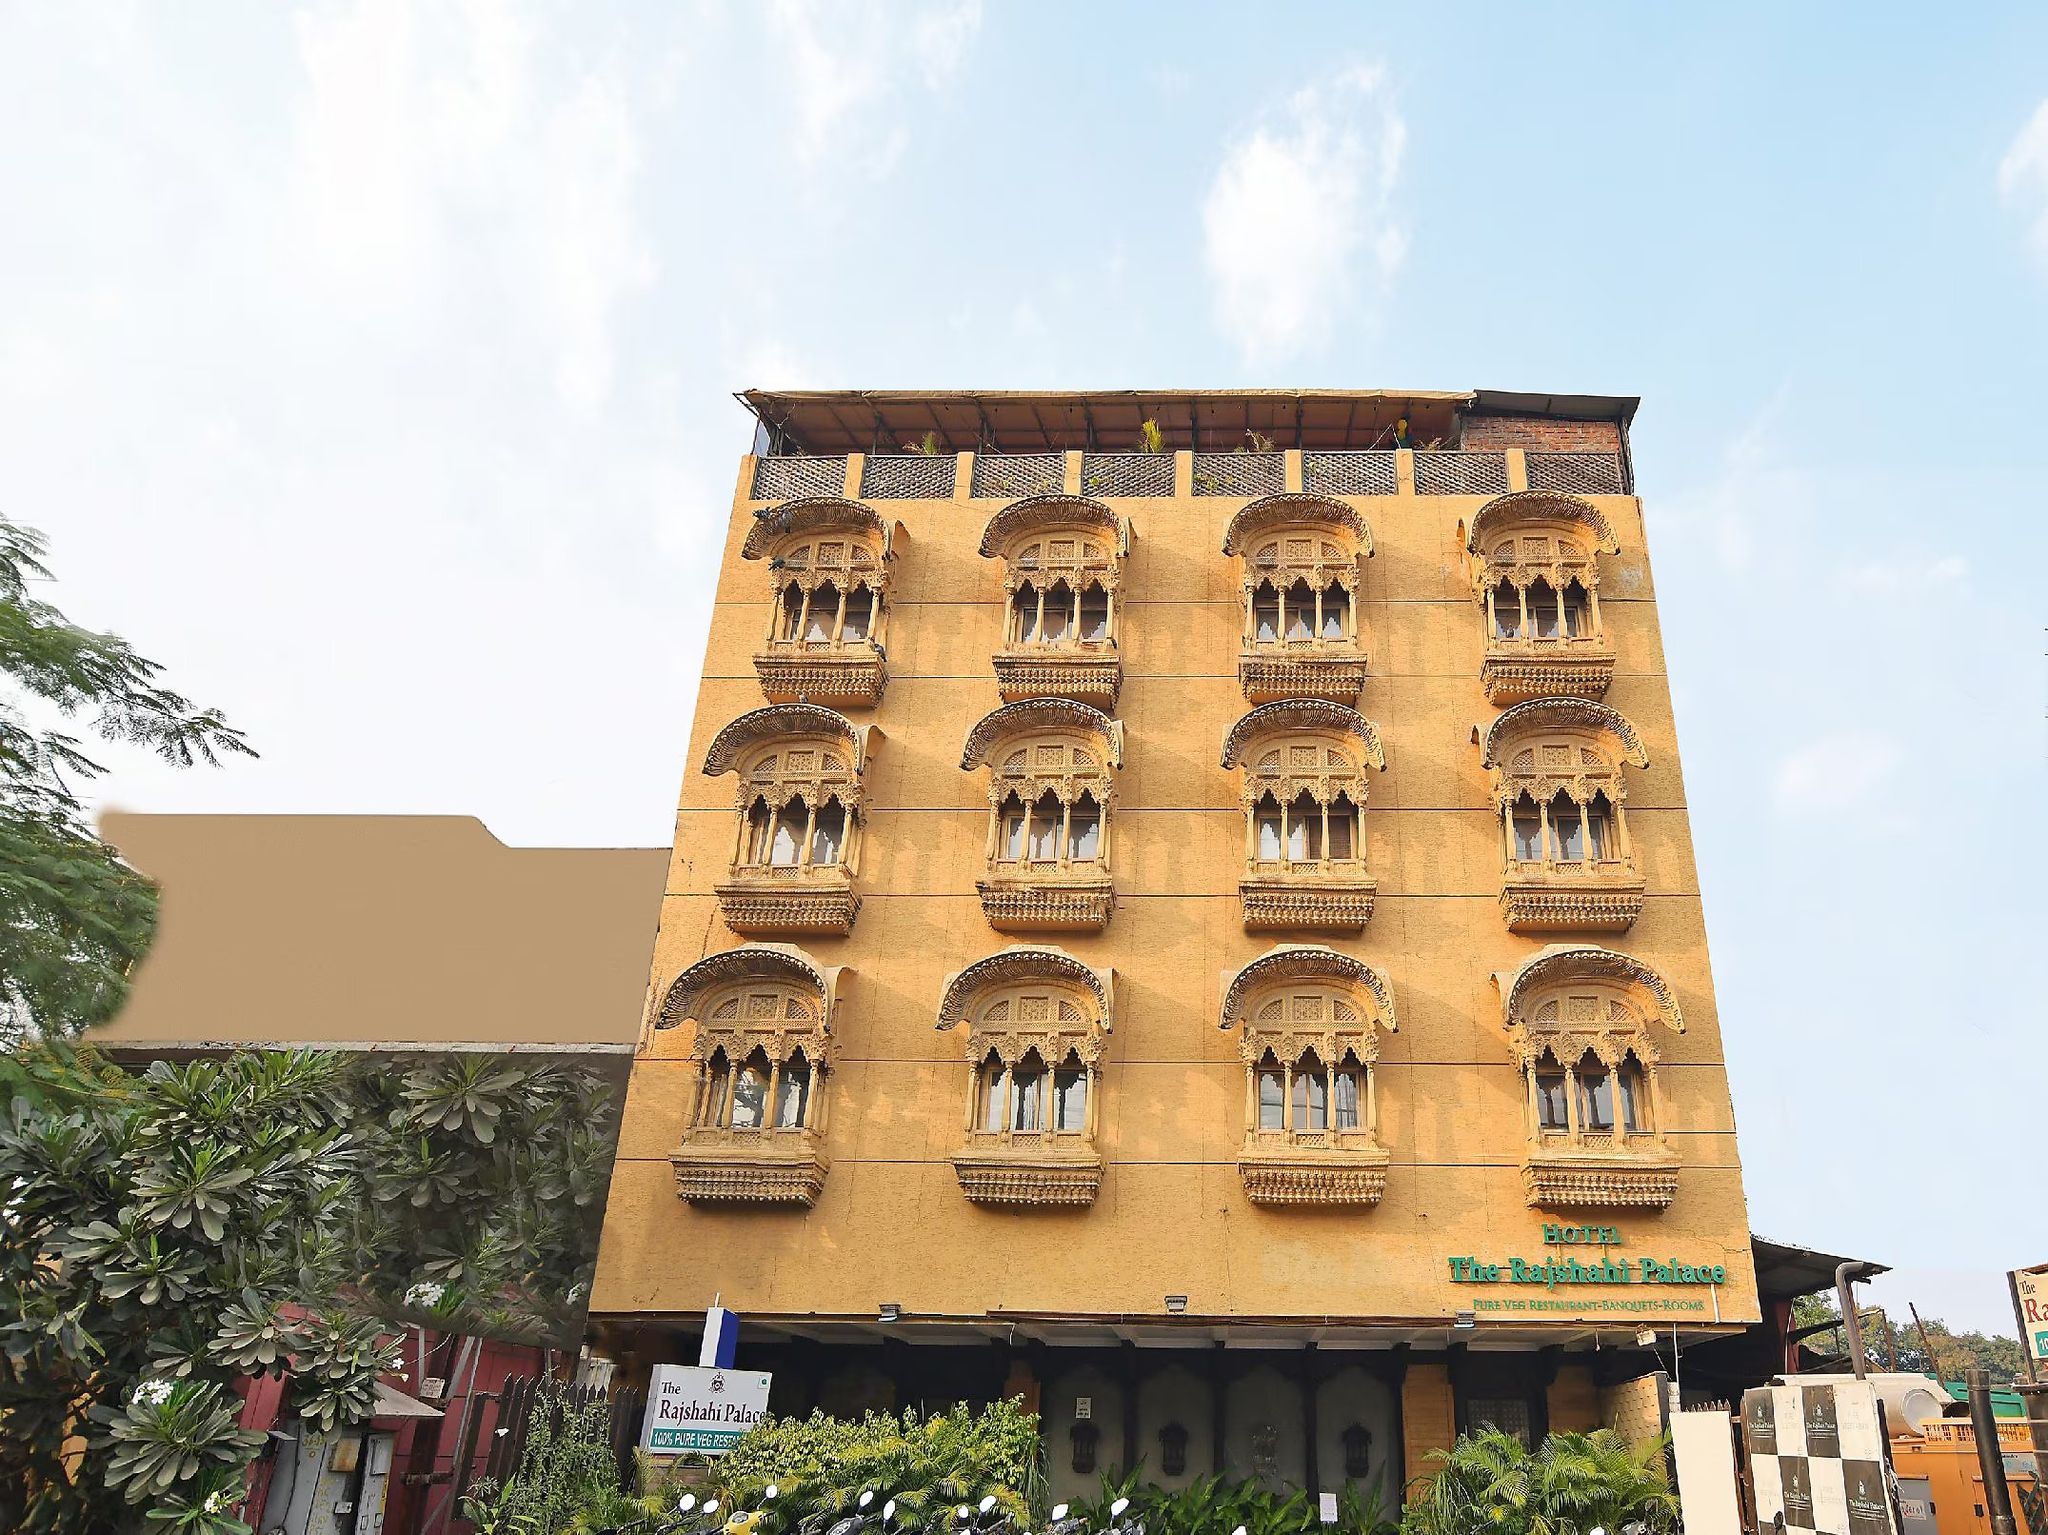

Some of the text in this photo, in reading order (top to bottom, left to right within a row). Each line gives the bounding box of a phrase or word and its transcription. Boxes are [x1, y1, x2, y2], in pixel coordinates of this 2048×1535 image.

[1542, 1223, 1622, 1244] HOTEL
[1448, 1256, 1727, 1291] The Rajshahi Palace
[2019, 1280, 2036, 1295] The
[661, 1381, 681, 1395] The
[658, 1399, 765, 1427] Rajshahi Palace
[654, 1431, 674, 1446] 100%
[675, 1432, 696, 1446] PURE
[697, 1433, 713, 1447] VEG
